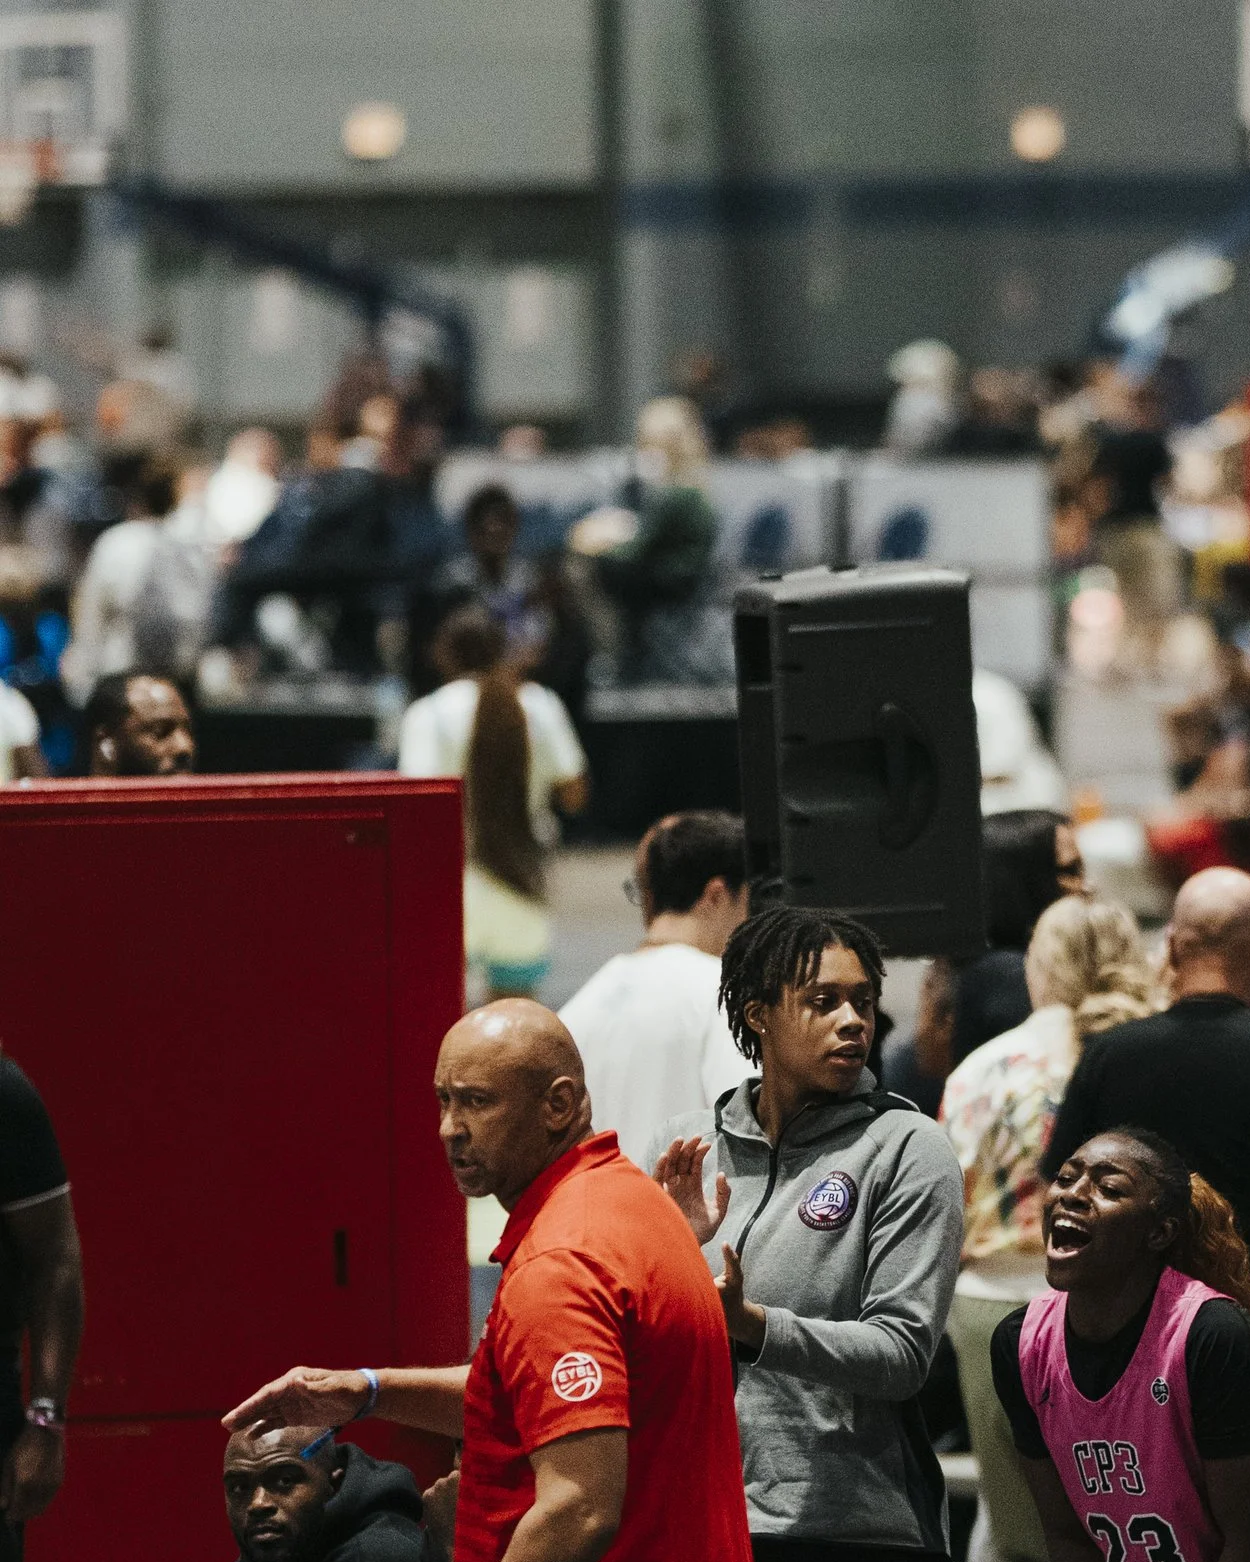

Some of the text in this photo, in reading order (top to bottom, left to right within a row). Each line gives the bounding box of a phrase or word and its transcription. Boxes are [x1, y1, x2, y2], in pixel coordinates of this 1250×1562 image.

[814, 1193, 841, 1203] EYBL
[557, 1364, 596, 1383] EYBL
[1072, 1439, 1146, 1496] CP3
